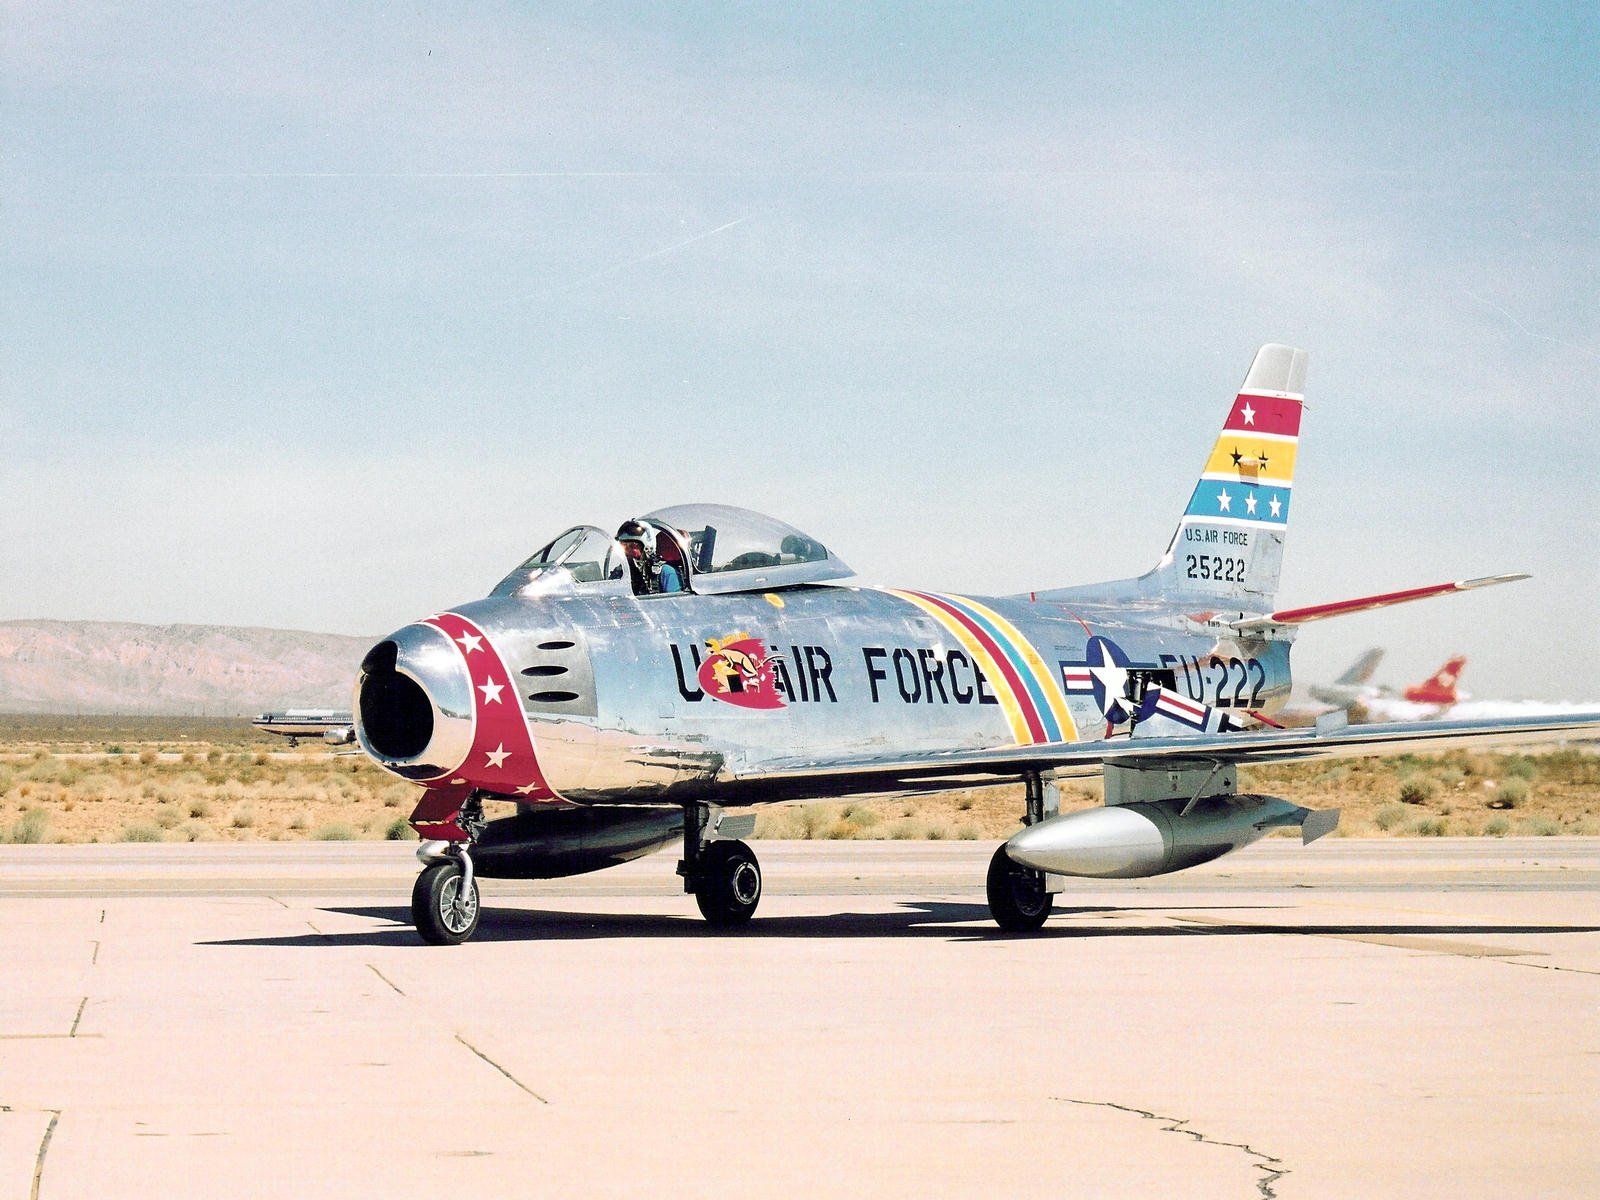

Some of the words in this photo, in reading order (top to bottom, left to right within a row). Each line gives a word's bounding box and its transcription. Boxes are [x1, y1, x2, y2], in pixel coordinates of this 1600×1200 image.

[1223, 531, 1248, 546] FORCE
[1186, 554, 1245, 582] 25222
[862, 647, 999, 704] FORCE
